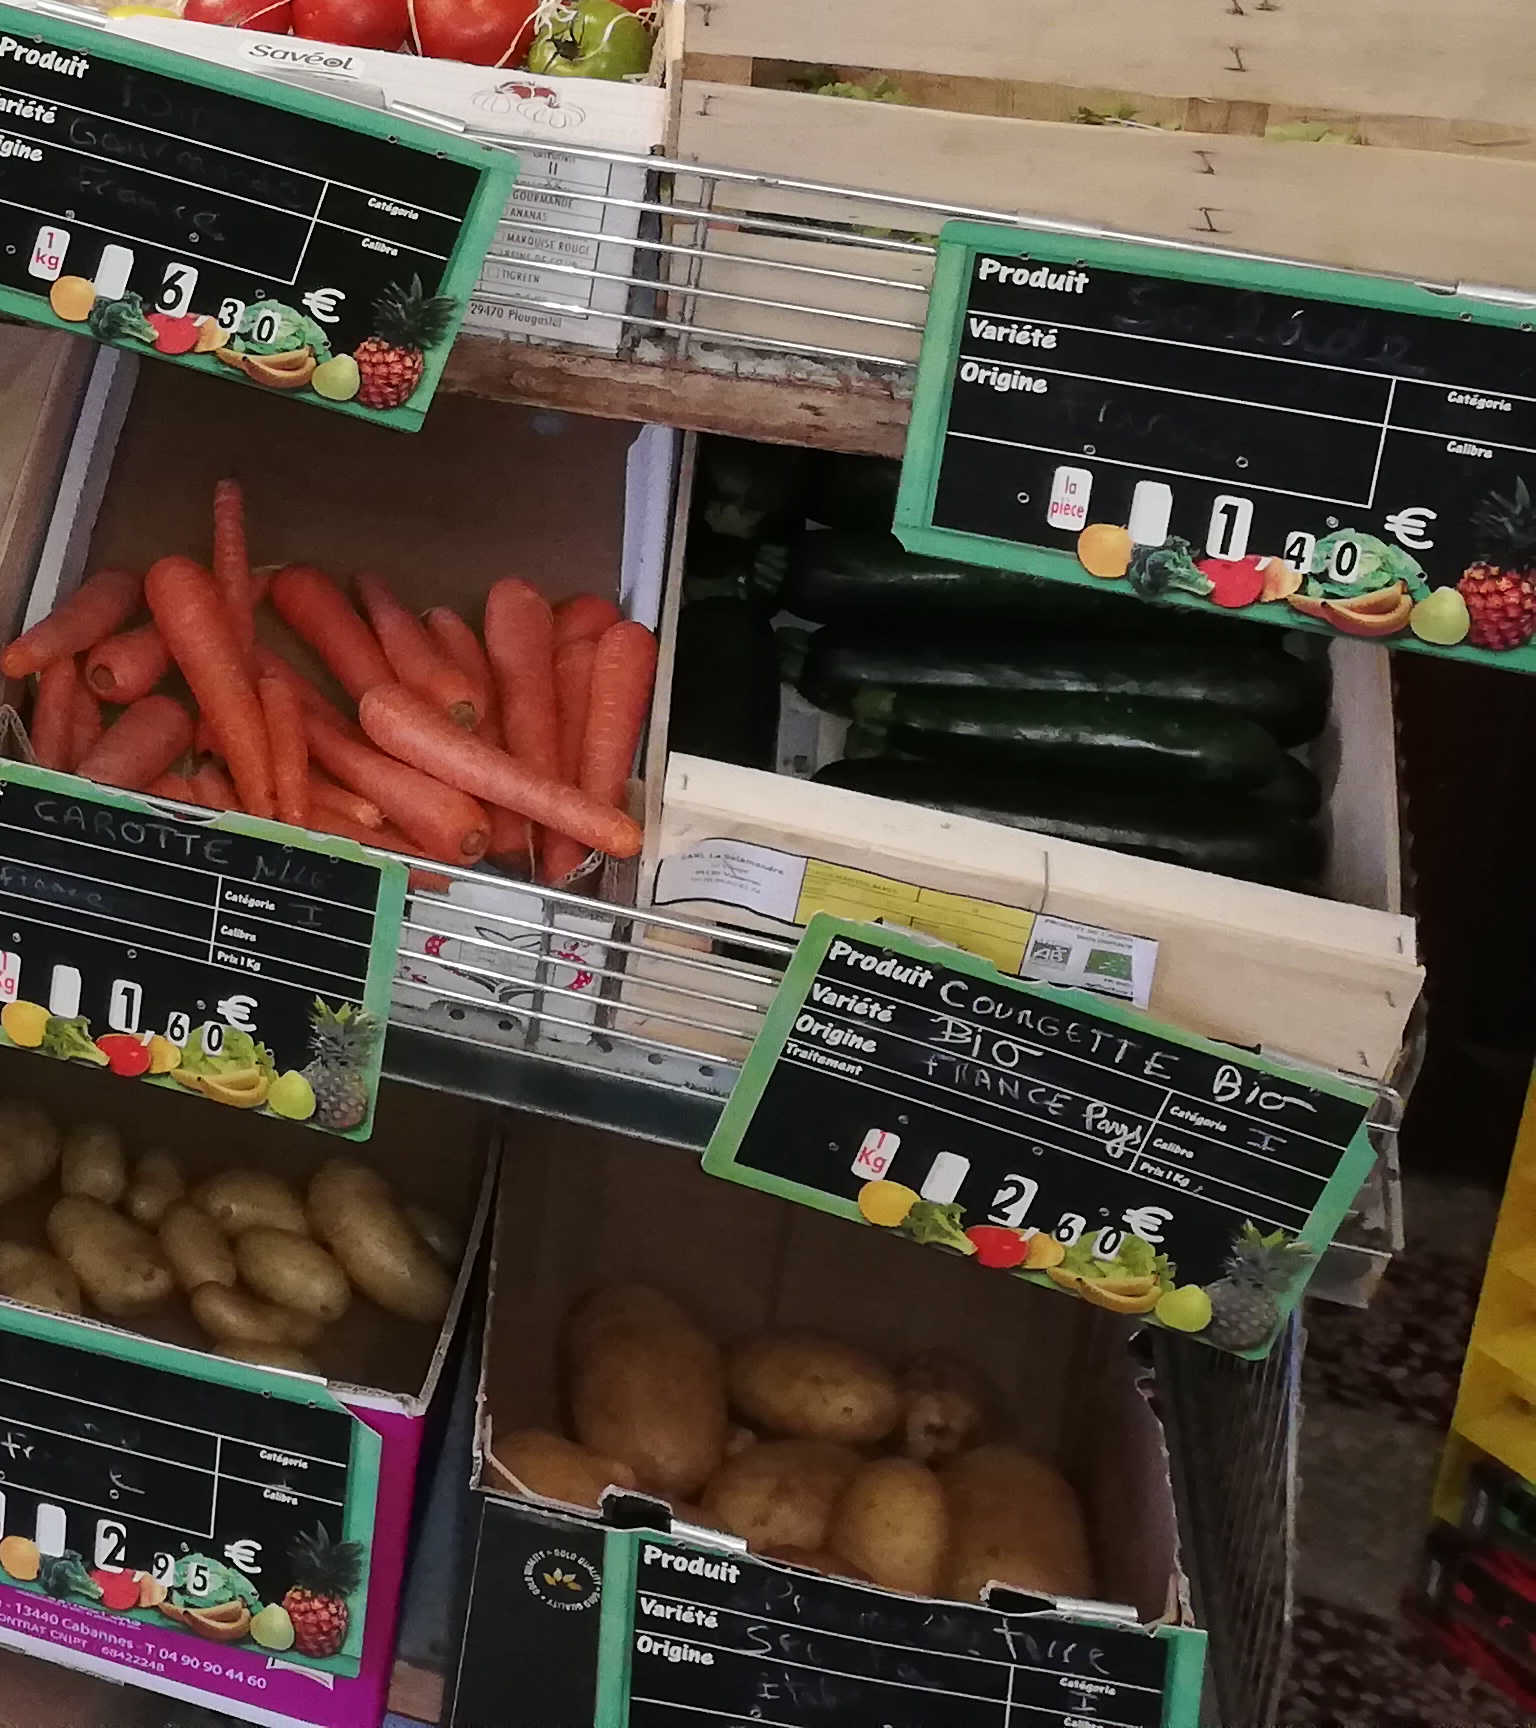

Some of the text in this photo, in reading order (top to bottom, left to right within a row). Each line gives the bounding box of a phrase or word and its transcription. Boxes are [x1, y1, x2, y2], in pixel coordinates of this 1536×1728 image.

[247, 42, 355, 73] Savéol
[558, 242, 590, 256] ROUGE
[977, 256, 1091, 297] Produit
[470, 302, 504, 318] 29470
[959, 361, 1049, 395] Origine
[967, 316, 1513, 413] Variété Catégorie
[1063, 476, 1079, 497] la
[1050, 496, 1086, 522] pièce
[33, 800, 235, 865] CAROTTE
[224, 890, 277, 911] Catégorie
[810, 982, 894, 1026] Variété
[828, 939, 934, 989] Produit
[941, 978, 1182, 1082] COURGETTE
[785, 1041, 865, 1077] Traitement
[794, 1013, 878, 1055] Origine
[922, 1052, 1071, 1116] FRANCE
[258, 1449, 309, 1471] Catégorie
[642, 1543, 743, 1586] Produit
[637, 1596, 720, 1632] Variété
[13, 1601, 60, 1628] 13440
[157, 1645, 178, 1662] 04
[179, 1651, 201, 1669] 90
[201, 1657, 224, 1675] 90
[224, 1665, 247, 1683] 44
[247, 1672, 268, 1690] 60
[634, 1633, 717, 1668] Origine
